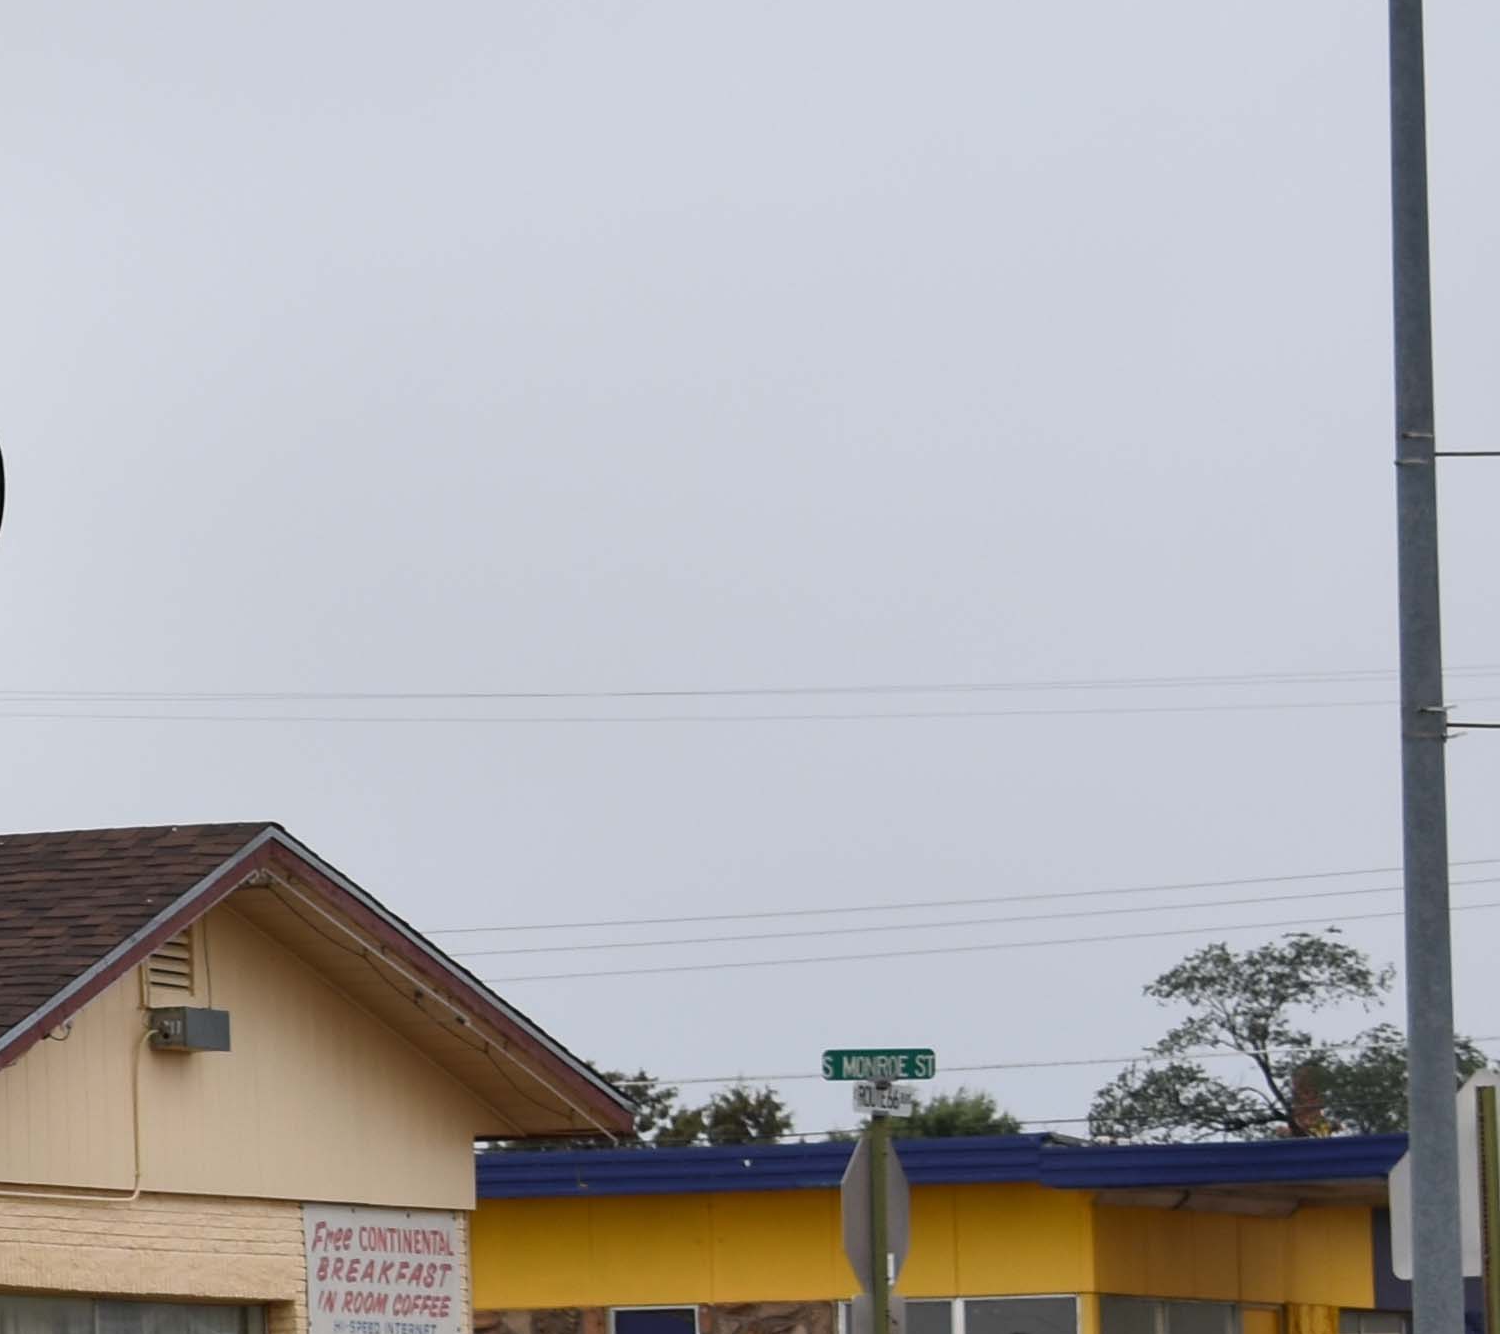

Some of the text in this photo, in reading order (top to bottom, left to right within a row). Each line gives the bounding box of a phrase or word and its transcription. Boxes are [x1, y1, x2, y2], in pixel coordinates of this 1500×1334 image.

[821, 1054, 935, 1079] S MONROE ST
[311, 1221, 455, 1257] Free CONTINENTAL
[316, 1256, 453, 1289] BREAKFAST
[317, 1289, 452, 1318] IN ROOM COFFEE
